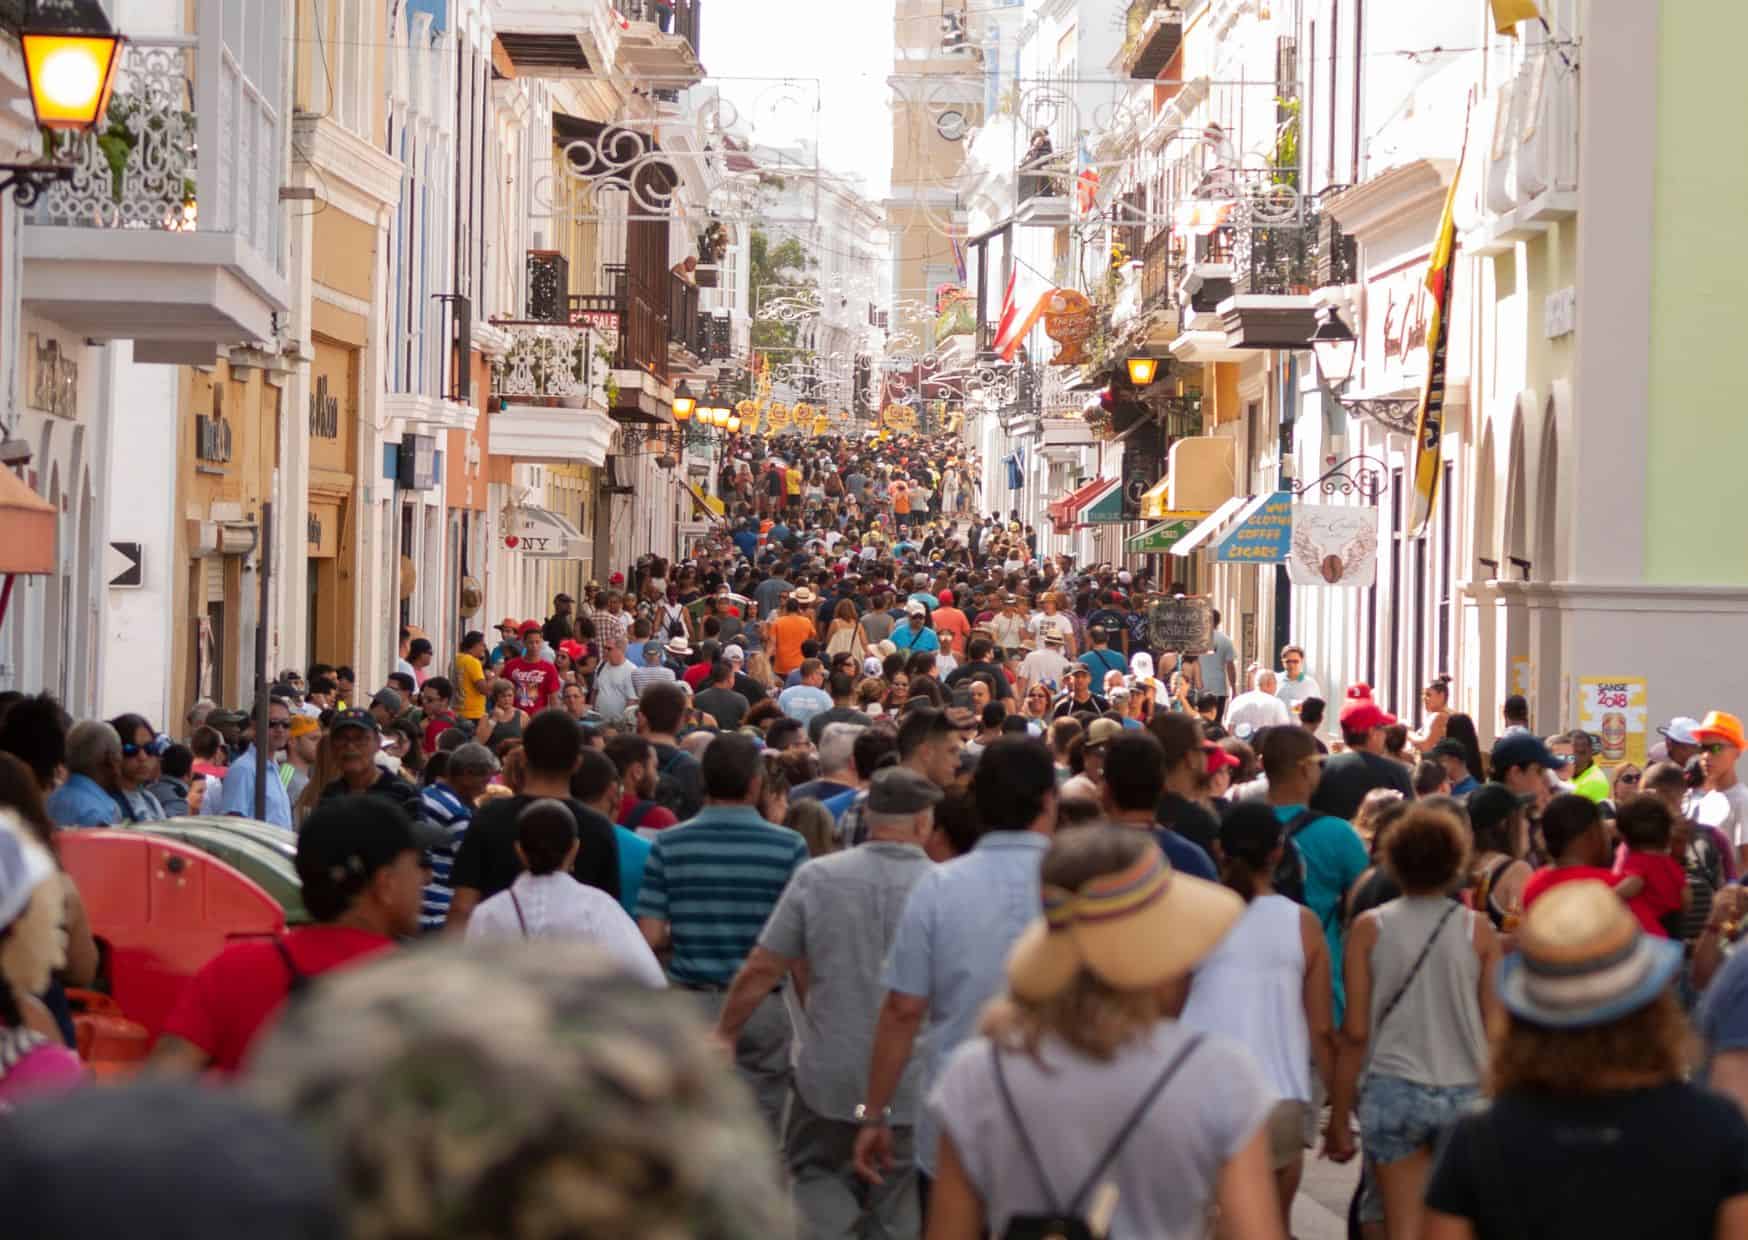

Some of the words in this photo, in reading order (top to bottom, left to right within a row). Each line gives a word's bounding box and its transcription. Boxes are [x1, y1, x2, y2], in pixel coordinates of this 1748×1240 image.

[592, 312, 617, 329] SALE
[1237, 528, 1281, 540] COFFEE
[521, 537, 550, 551] NY
[1228, 545, 1279, 558] CIGARS
[1597, 688, 1627, 708] 2018
